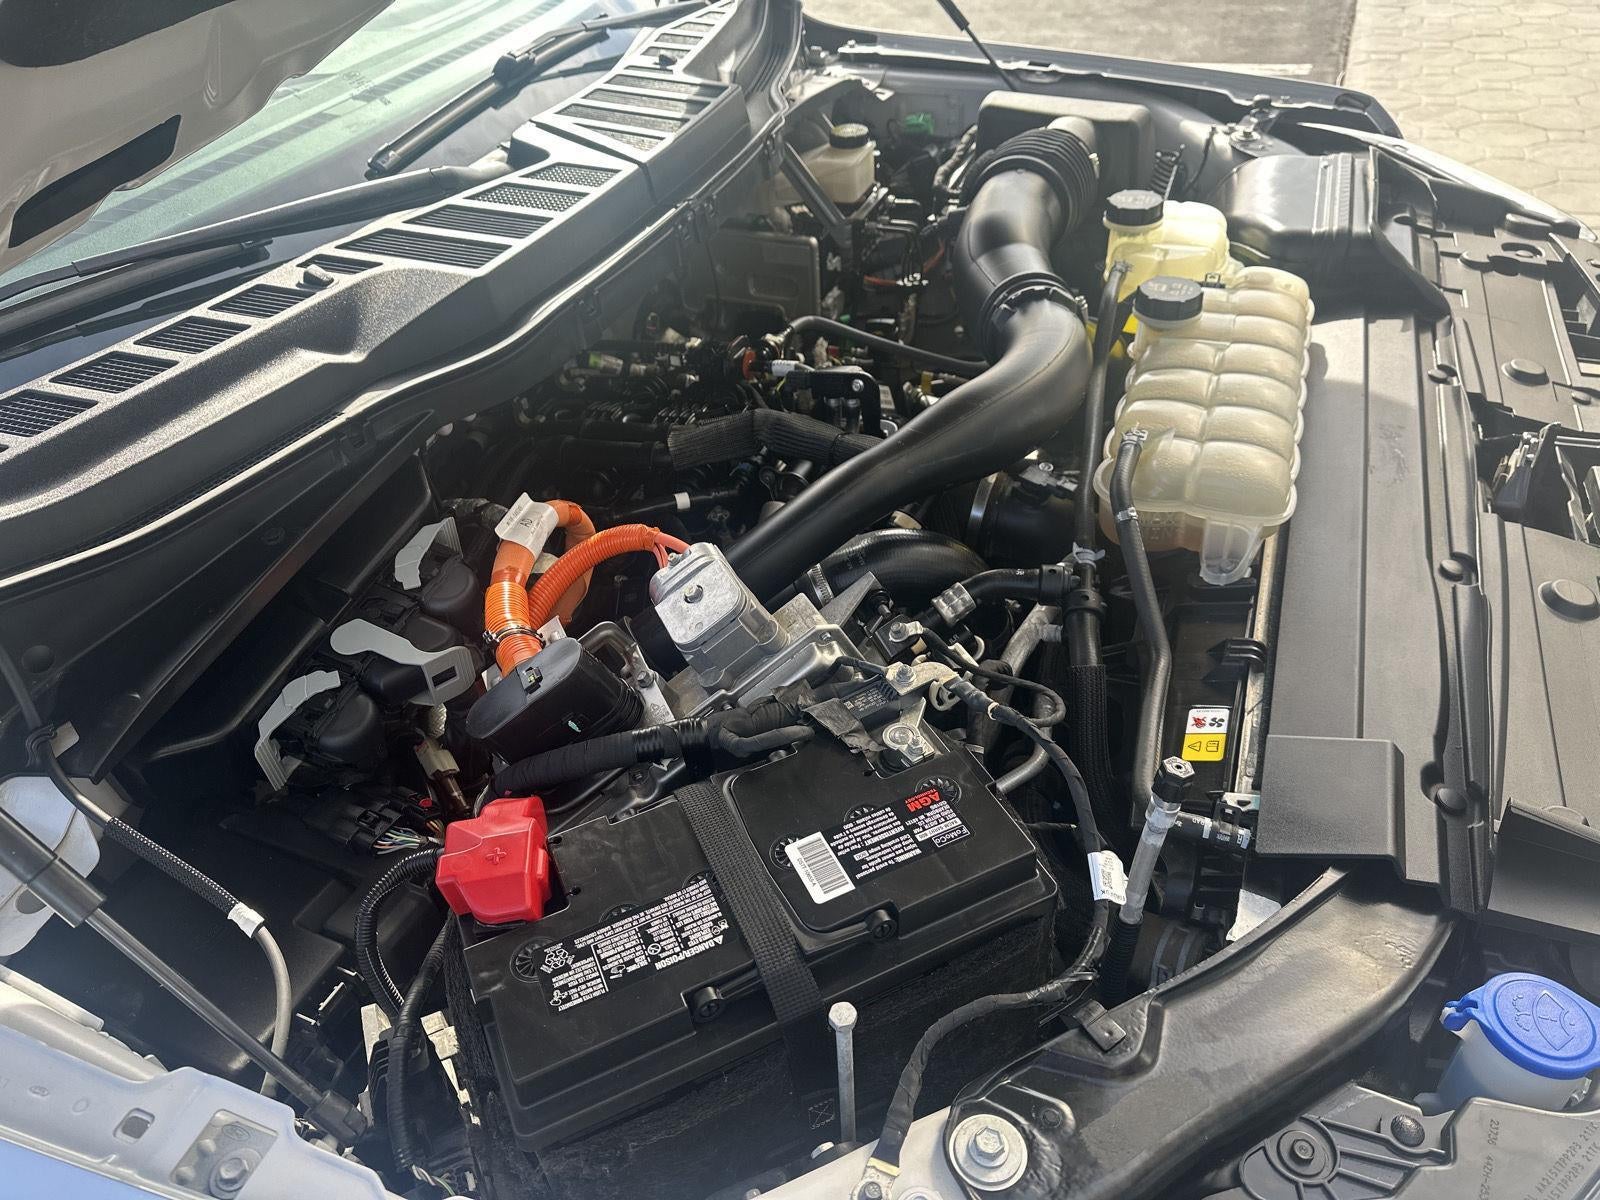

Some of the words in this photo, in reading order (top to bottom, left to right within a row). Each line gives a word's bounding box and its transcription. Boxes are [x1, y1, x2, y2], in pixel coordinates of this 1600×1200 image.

[905, 791, 942, 812] AGM
[934, 826, 967, 844] FoMoCo
[654, 938, 715, 970] DANGER/POISON
